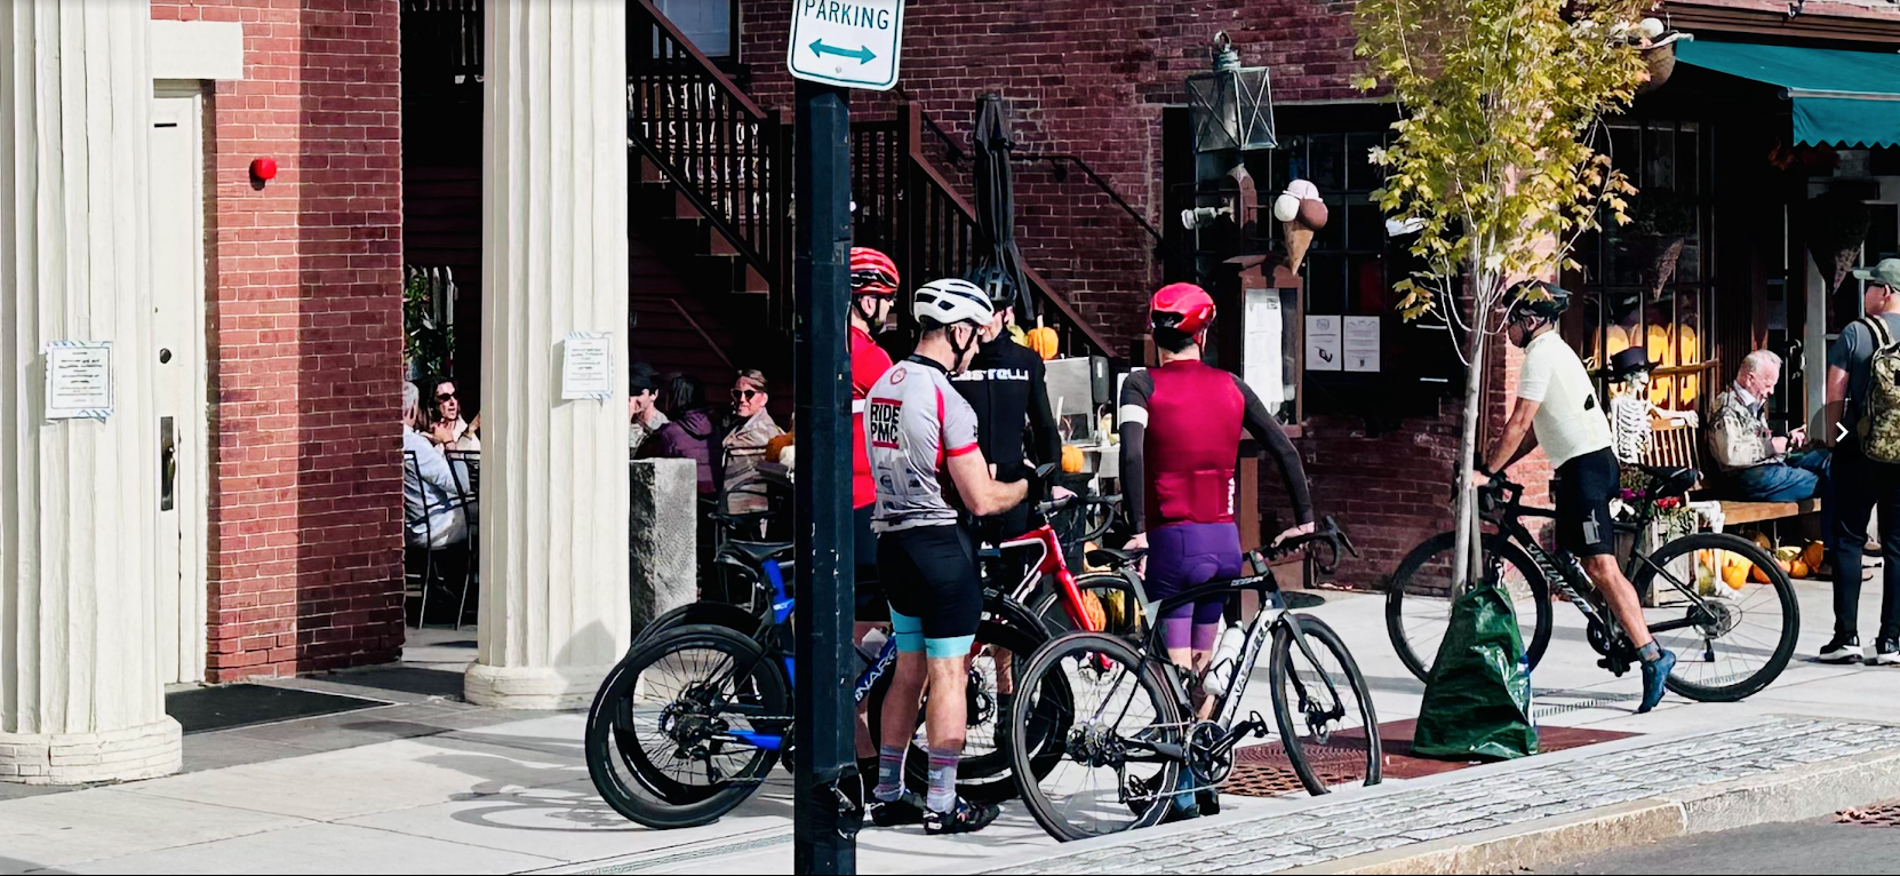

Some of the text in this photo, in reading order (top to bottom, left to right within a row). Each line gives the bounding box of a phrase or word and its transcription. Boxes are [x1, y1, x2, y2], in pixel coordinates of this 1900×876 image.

[804, 0, 890, 30] PARKING
[871, 404, 901, 424] RIDE
[871, 422, 898, 443] PMC
